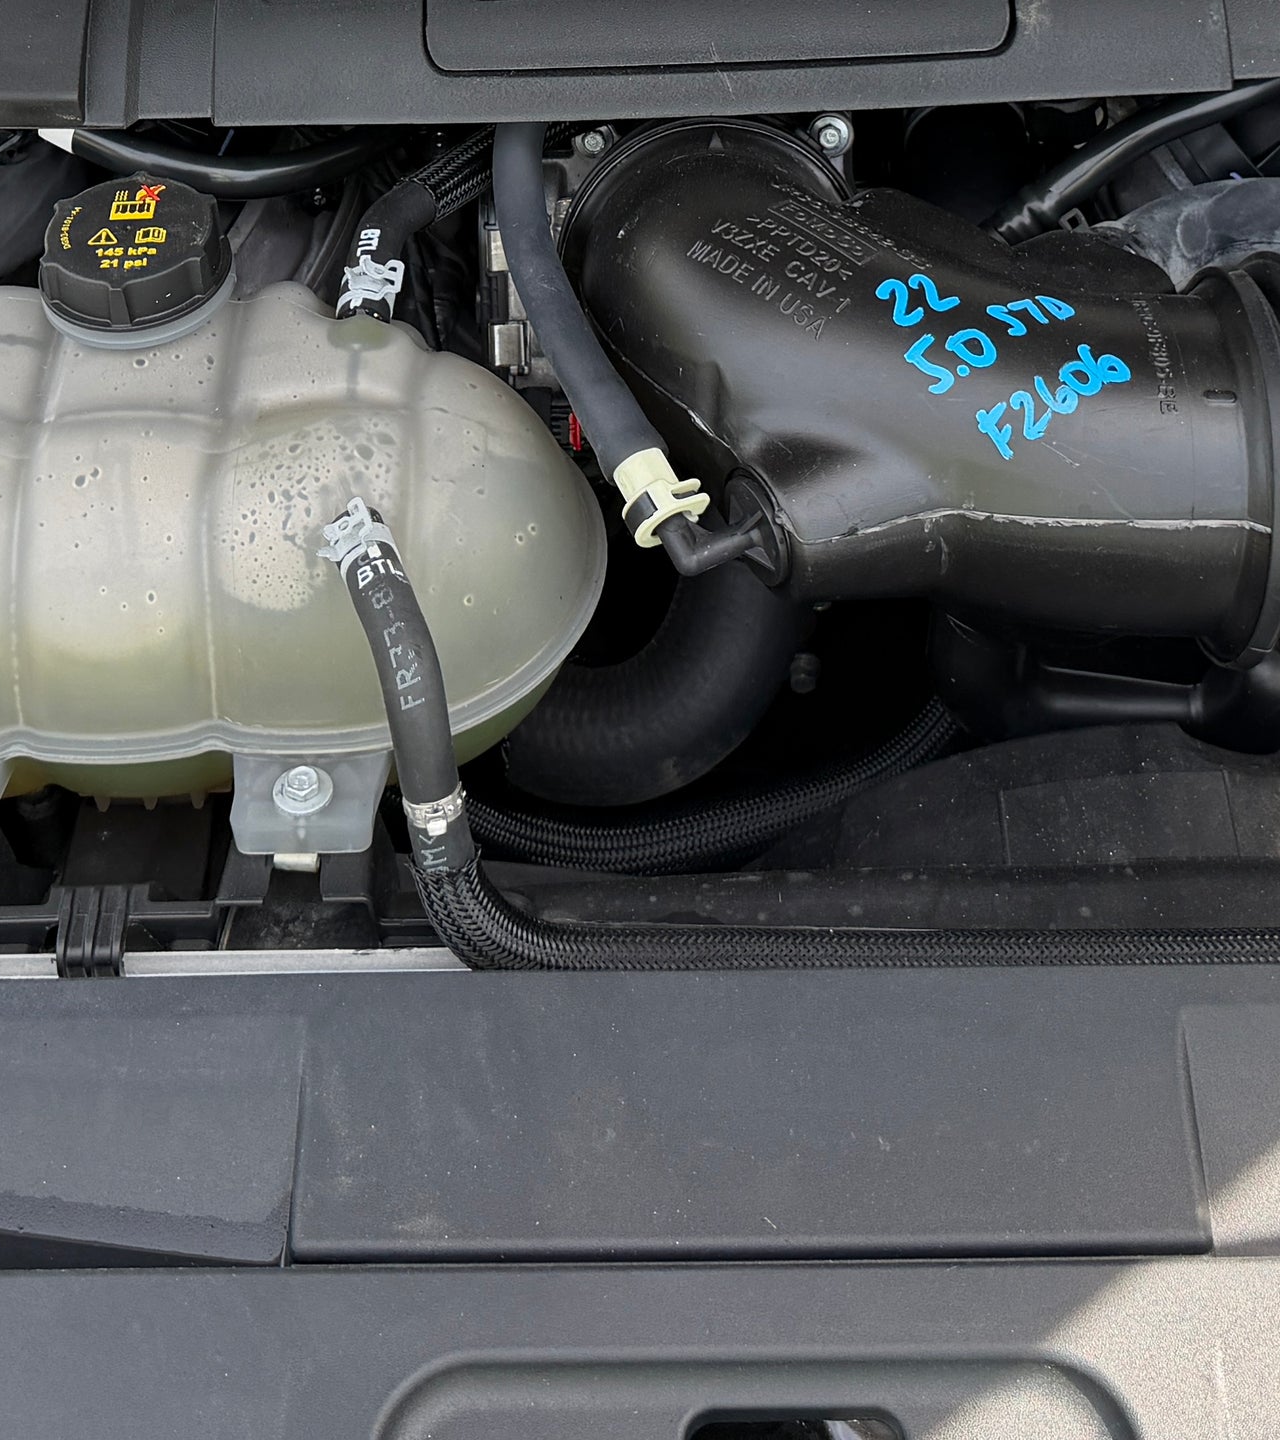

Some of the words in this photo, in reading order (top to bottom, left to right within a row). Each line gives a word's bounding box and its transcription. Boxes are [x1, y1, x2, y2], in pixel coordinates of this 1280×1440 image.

[95, 247, 124, 258] 145
[127, 247, 157, 257] kPa
[99, 258, 119, 269] 21
[123, 258, 148, 270] psi
[686, 240, 755, 285] MADE
[751, 274, 781, 301] IN
[779, 292, 828, 340] USA
[874, 273, 961, 327] 22
[904, 328, 997, 394] 5.0
[986, 295, 1076, 336] STD
[975, 343, 1132, 461] F2606
